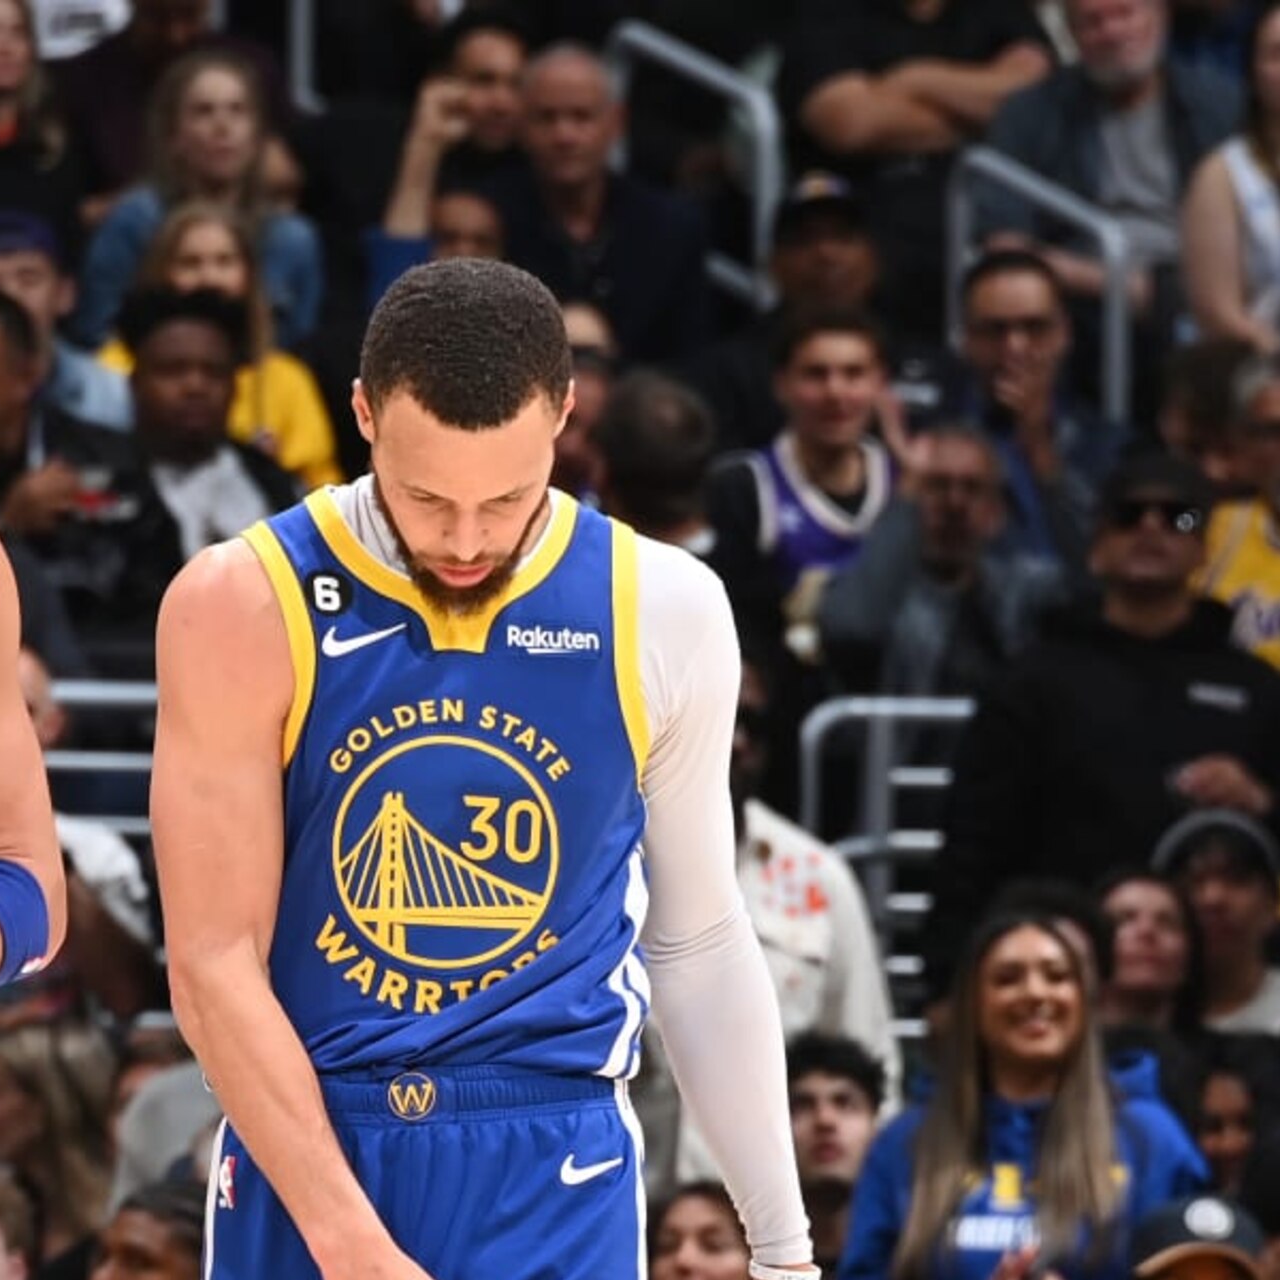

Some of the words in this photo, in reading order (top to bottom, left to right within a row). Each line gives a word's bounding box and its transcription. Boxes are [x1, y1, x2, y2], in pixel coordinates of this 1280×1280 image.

[313, 576, 342, 611] 6
[506, 624, 601, 655] Rakuten
[329, 699, 465, 775] GOLDEN
[478, 705, 573, 783] STATE
[459, 794, 544, 864] 30
[389, 1082, 434, 1114] W
